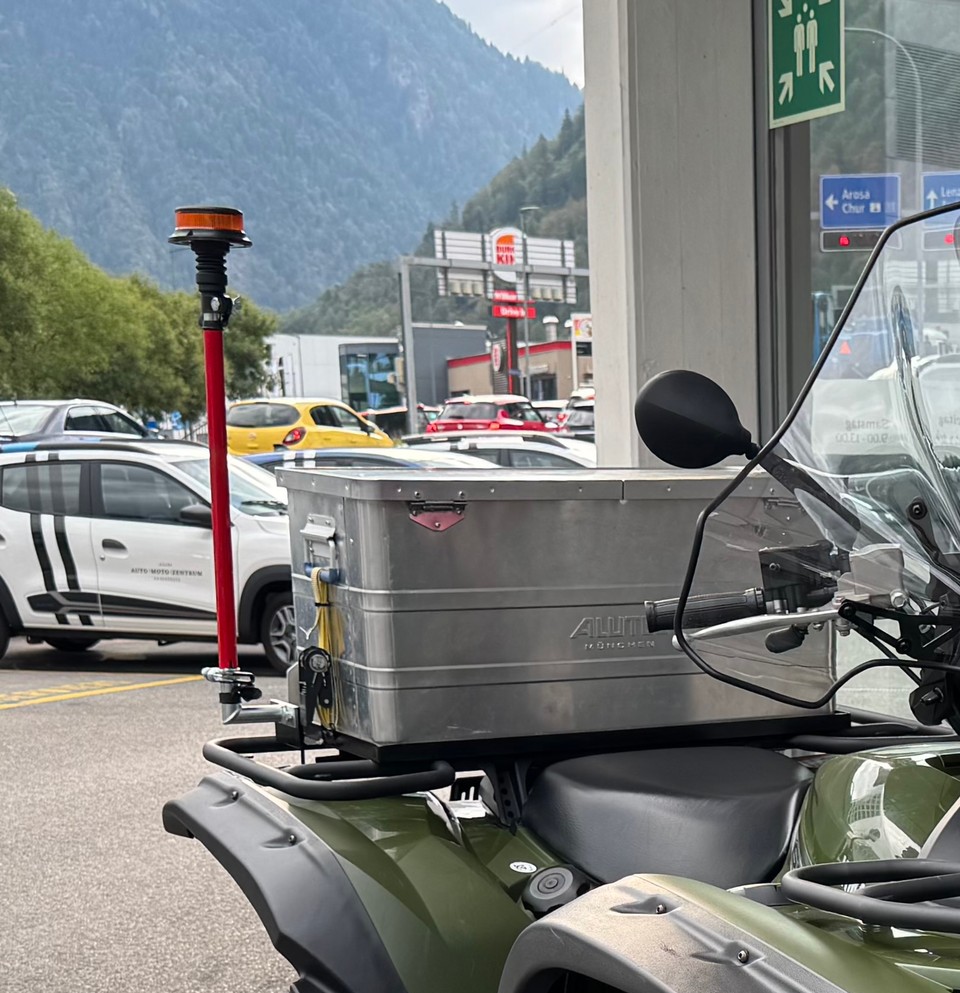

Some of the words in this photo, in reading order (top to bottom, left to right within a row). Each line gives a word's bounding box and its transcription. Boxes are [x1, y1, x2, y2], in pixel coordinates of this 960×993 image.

[841, 188, 871, 200] Arosa
[841, 203, 865, 214] Chur
[130, 567, 149, 575] AUTO
[171, 569, 203, 577] ZENTRUM
